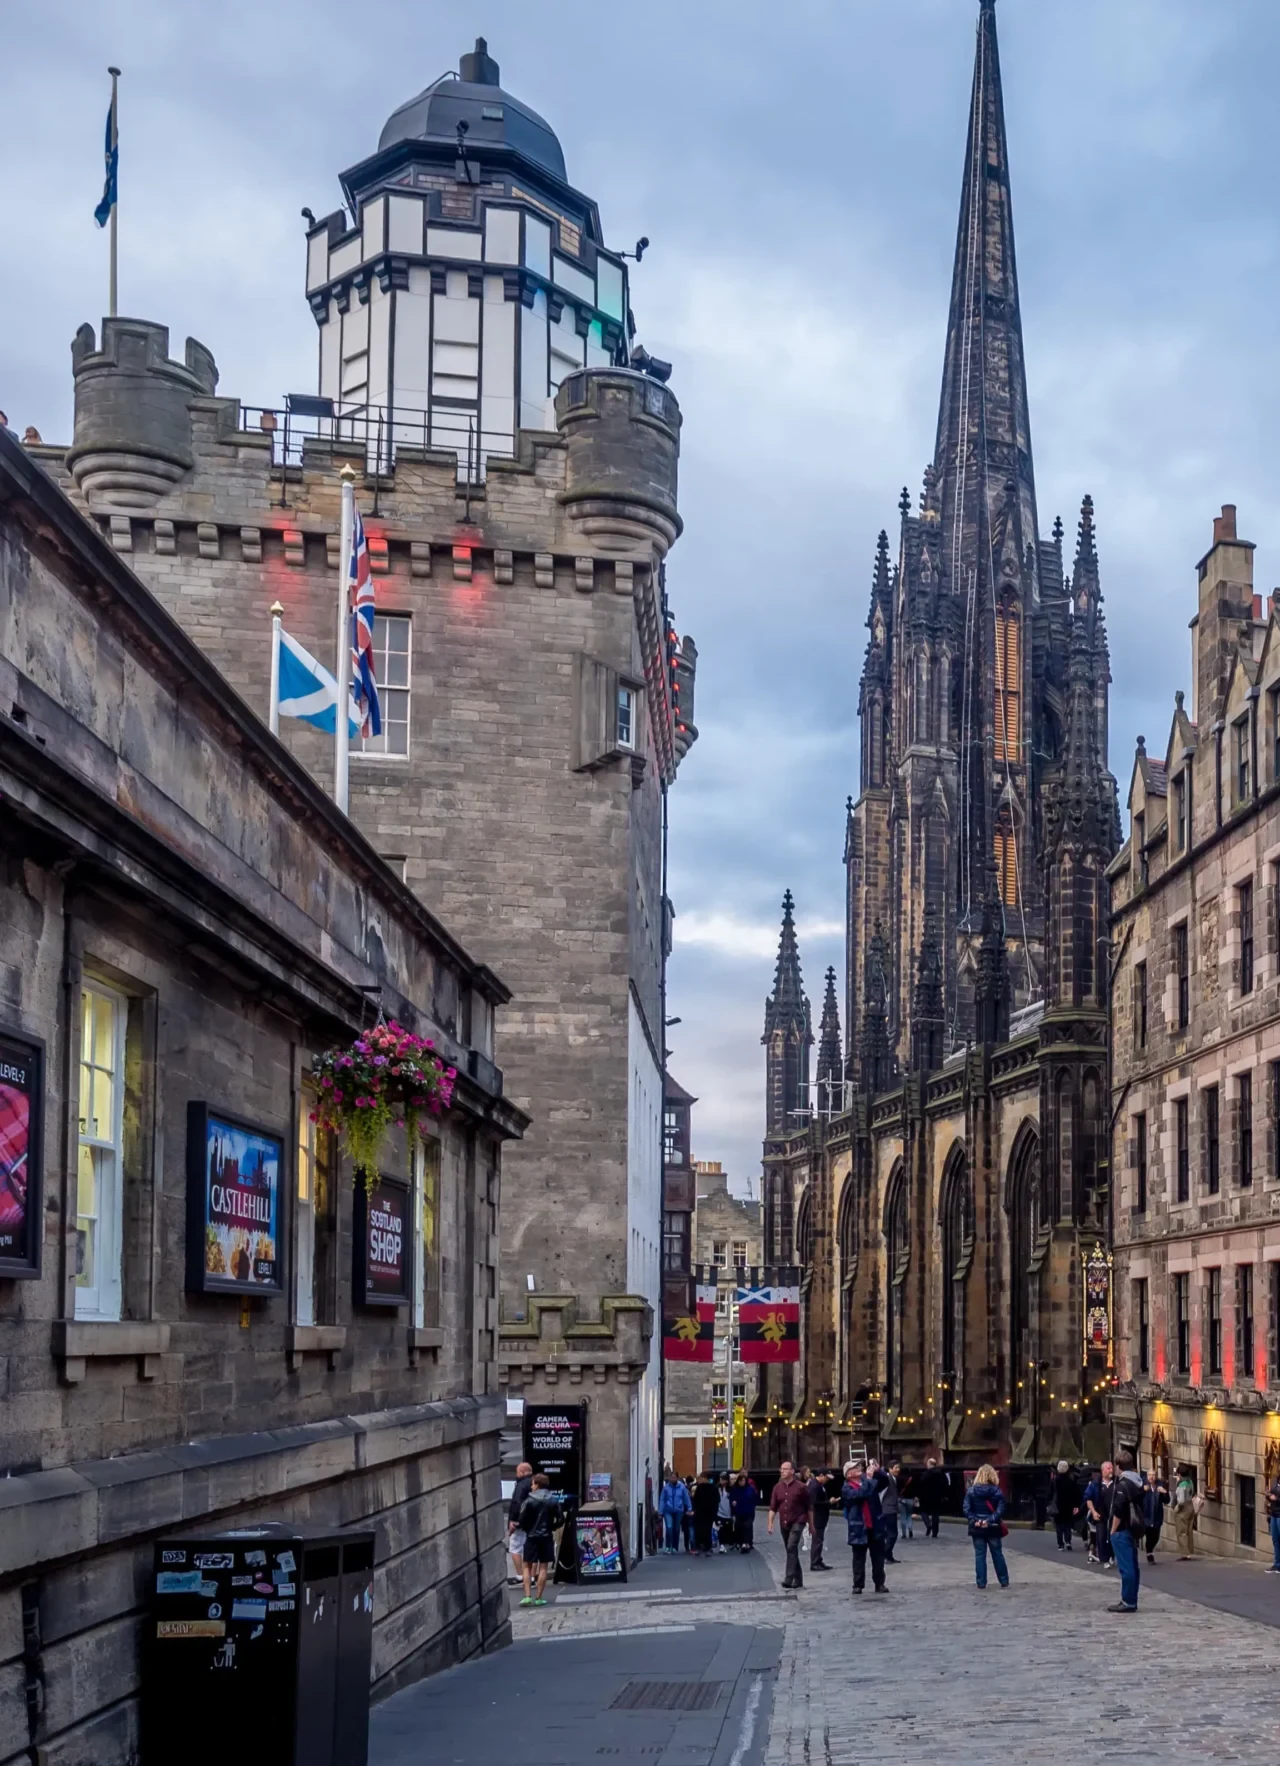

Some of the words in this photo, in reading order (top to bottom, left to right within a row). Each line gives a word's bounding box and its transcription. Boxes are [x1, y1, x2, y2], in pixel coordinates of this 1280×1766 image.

[211, 1184, 271, 1223] CASTLEHILL
[370, 1209, 402, 1233] SCOTLAND
[370, 1228, 402, 1265] SHOP
